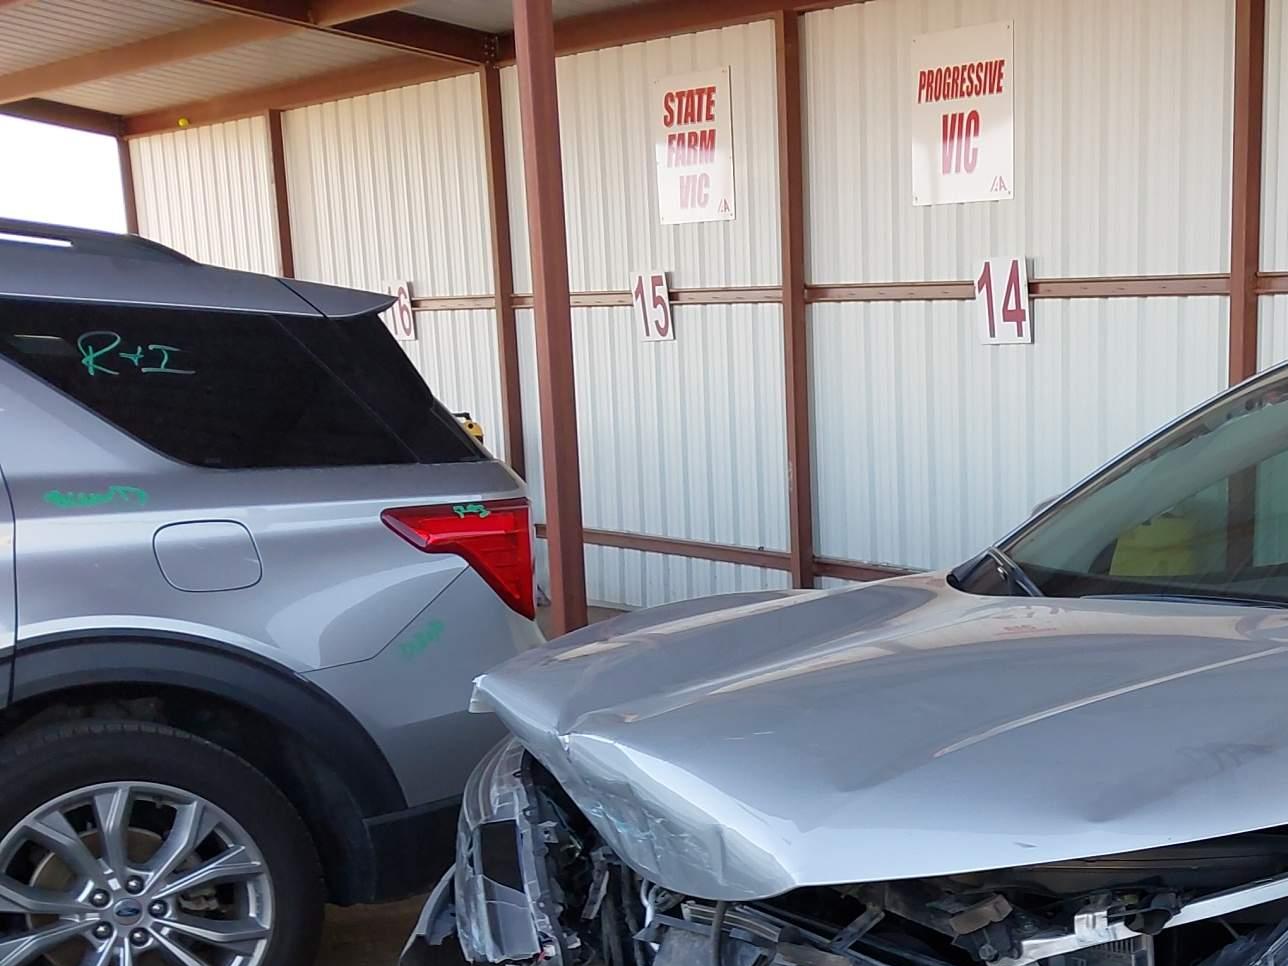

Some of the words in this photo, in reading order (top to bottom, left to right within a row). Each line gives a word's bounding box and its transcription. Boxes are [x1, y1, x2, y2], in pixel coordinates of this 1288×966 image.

[918, 59, 1005, 104] PROGRESSIVE
[663, 86, 717, 128] STATE
[667, 129, 717, 168] FARM
[942, 110, 980, 175] VIC
[680, 172, 710, 210] VIC
[635, 275, 669, 337] 15
[978, 260, 1026, 338] 14
